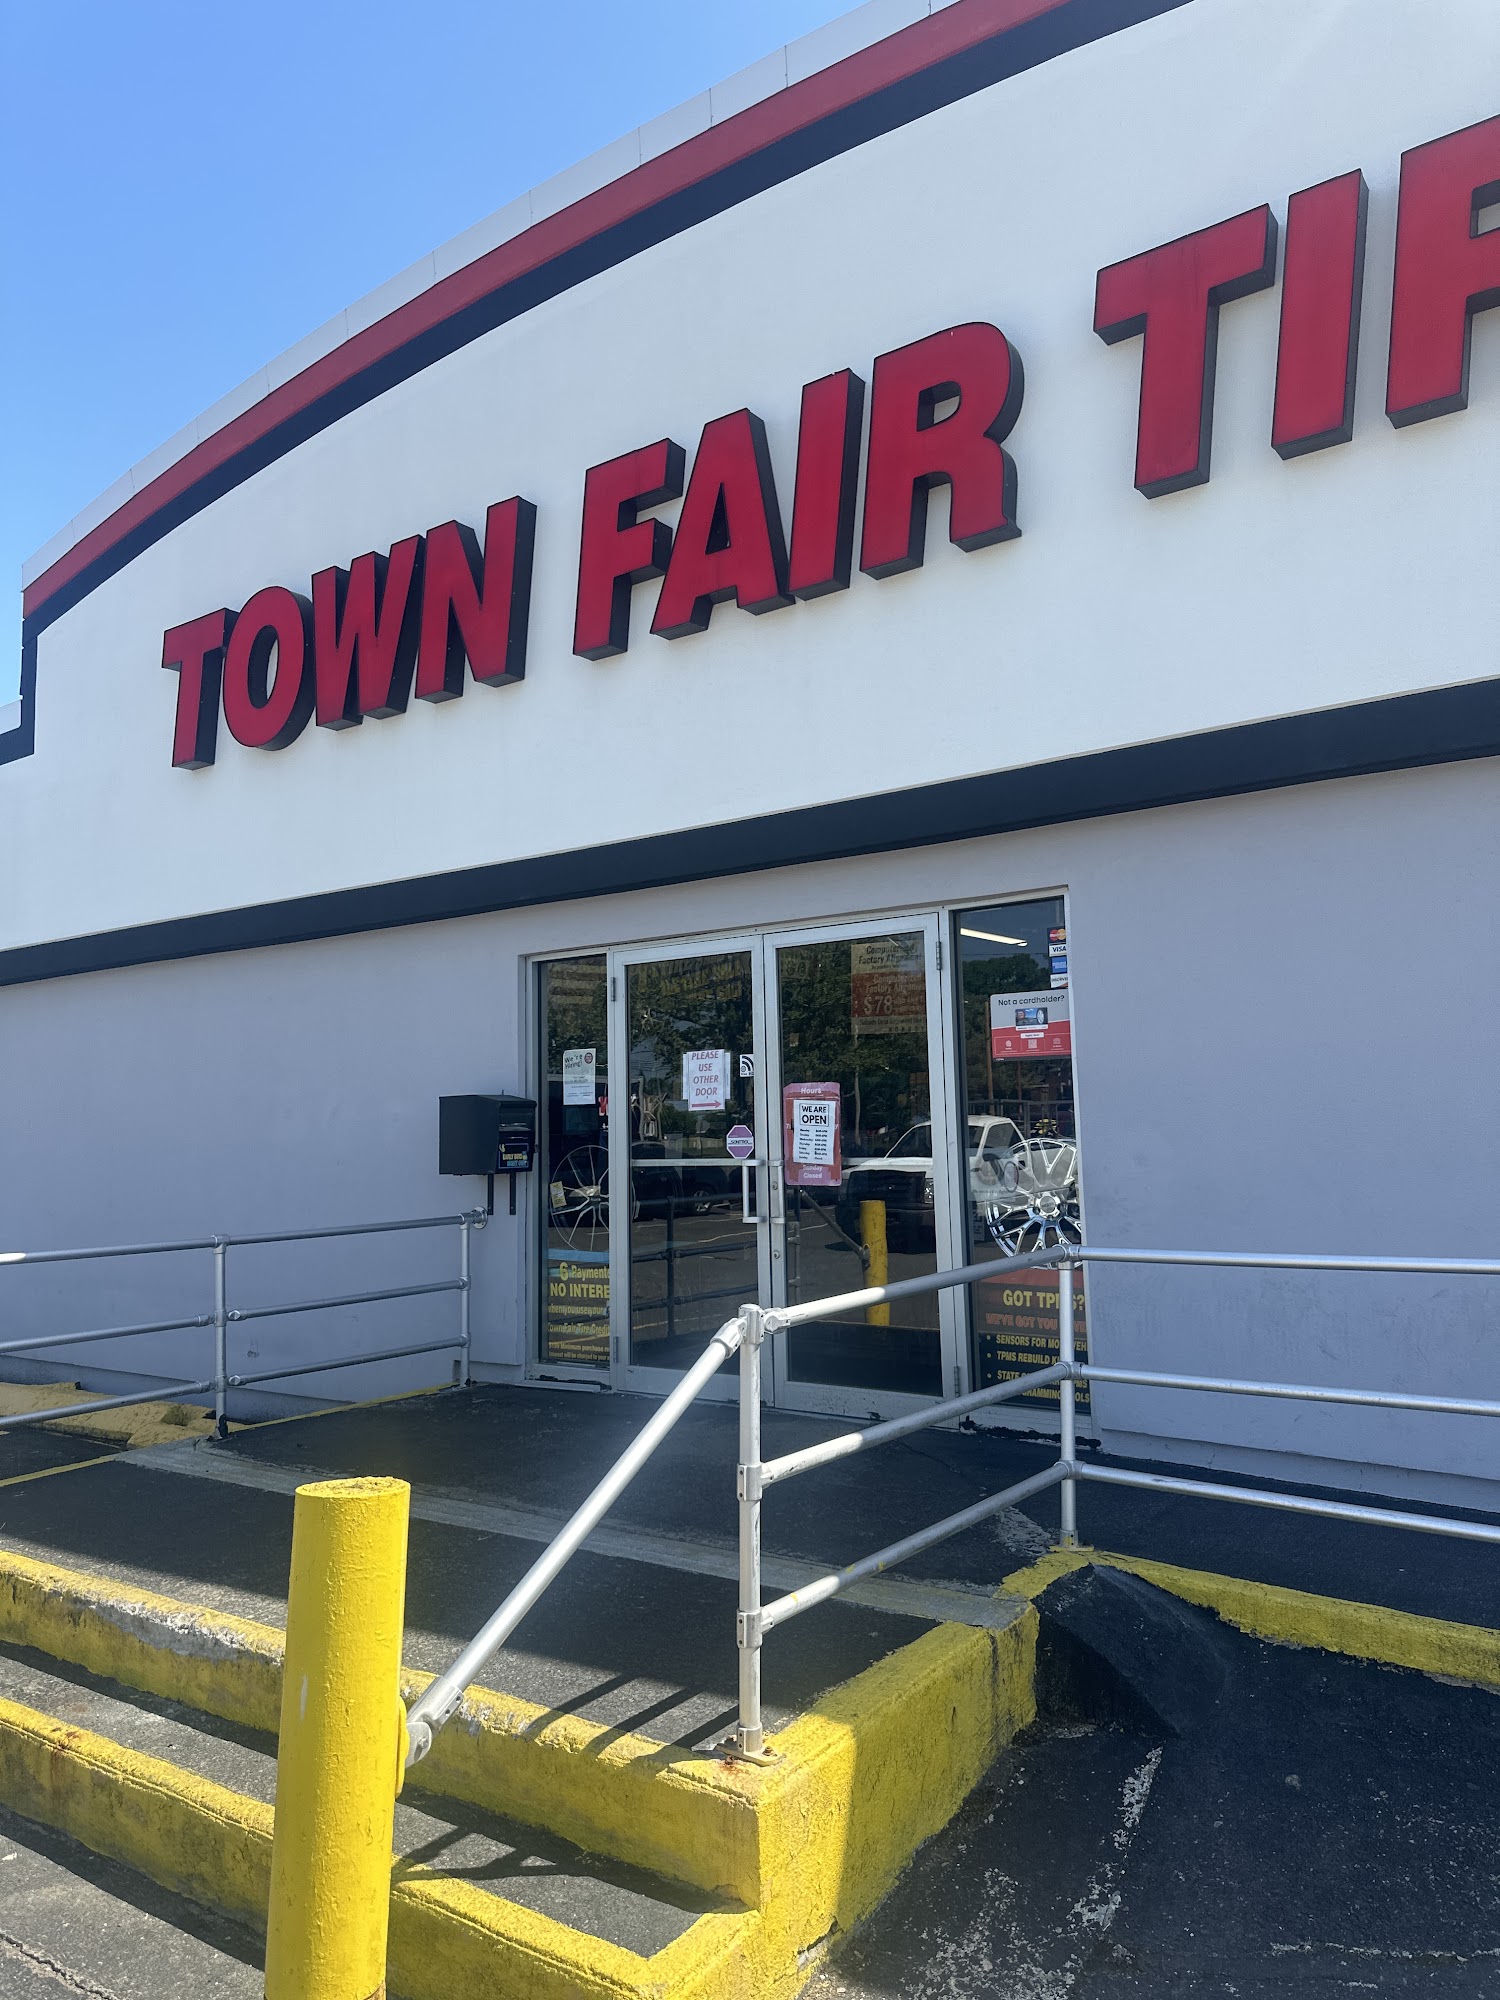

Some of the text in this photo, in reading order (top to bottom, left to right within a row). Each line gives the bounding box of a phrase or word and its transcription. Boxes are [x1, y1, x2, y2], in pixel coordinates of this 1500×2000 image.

[162, 495, 537, 770] TOWN
[573, 322, 1025, 661] FAIR
[858, 955, 884, 964] Factory
[866, 984, 891, 994] Factory
[1019, 995, 1065, 1005] cardholder?
[864, 995, 893, 1016] $78
[692, 1050, 719, 1060] PLEASE
[698, 1063, 713, 1071] USE
[693, 1075, 719, 1084] OTHER
[695, 1087, 718, 1096] DOOR
[802, 1115, 827, 1124] OPEN
[560, 1262, 568, 1281] 6
[550, 1283, 610, 1299] NO INTERE
[1003, 1289, 1032, 1307] GOT
[986, 1312, 1058, 1330] WE'VE GOT YOU
[577, 1323, 590, 1334] Tire
[996, 1334, 1030, 1347] SENSORS
[1031, 1337, 1046, 1348] FOR
[997, 1351, 1016, 1361] TPMS
[1018, 1354, 1050, 1365] REBUILD
[997, 1370, 1020, 1380] STATE
